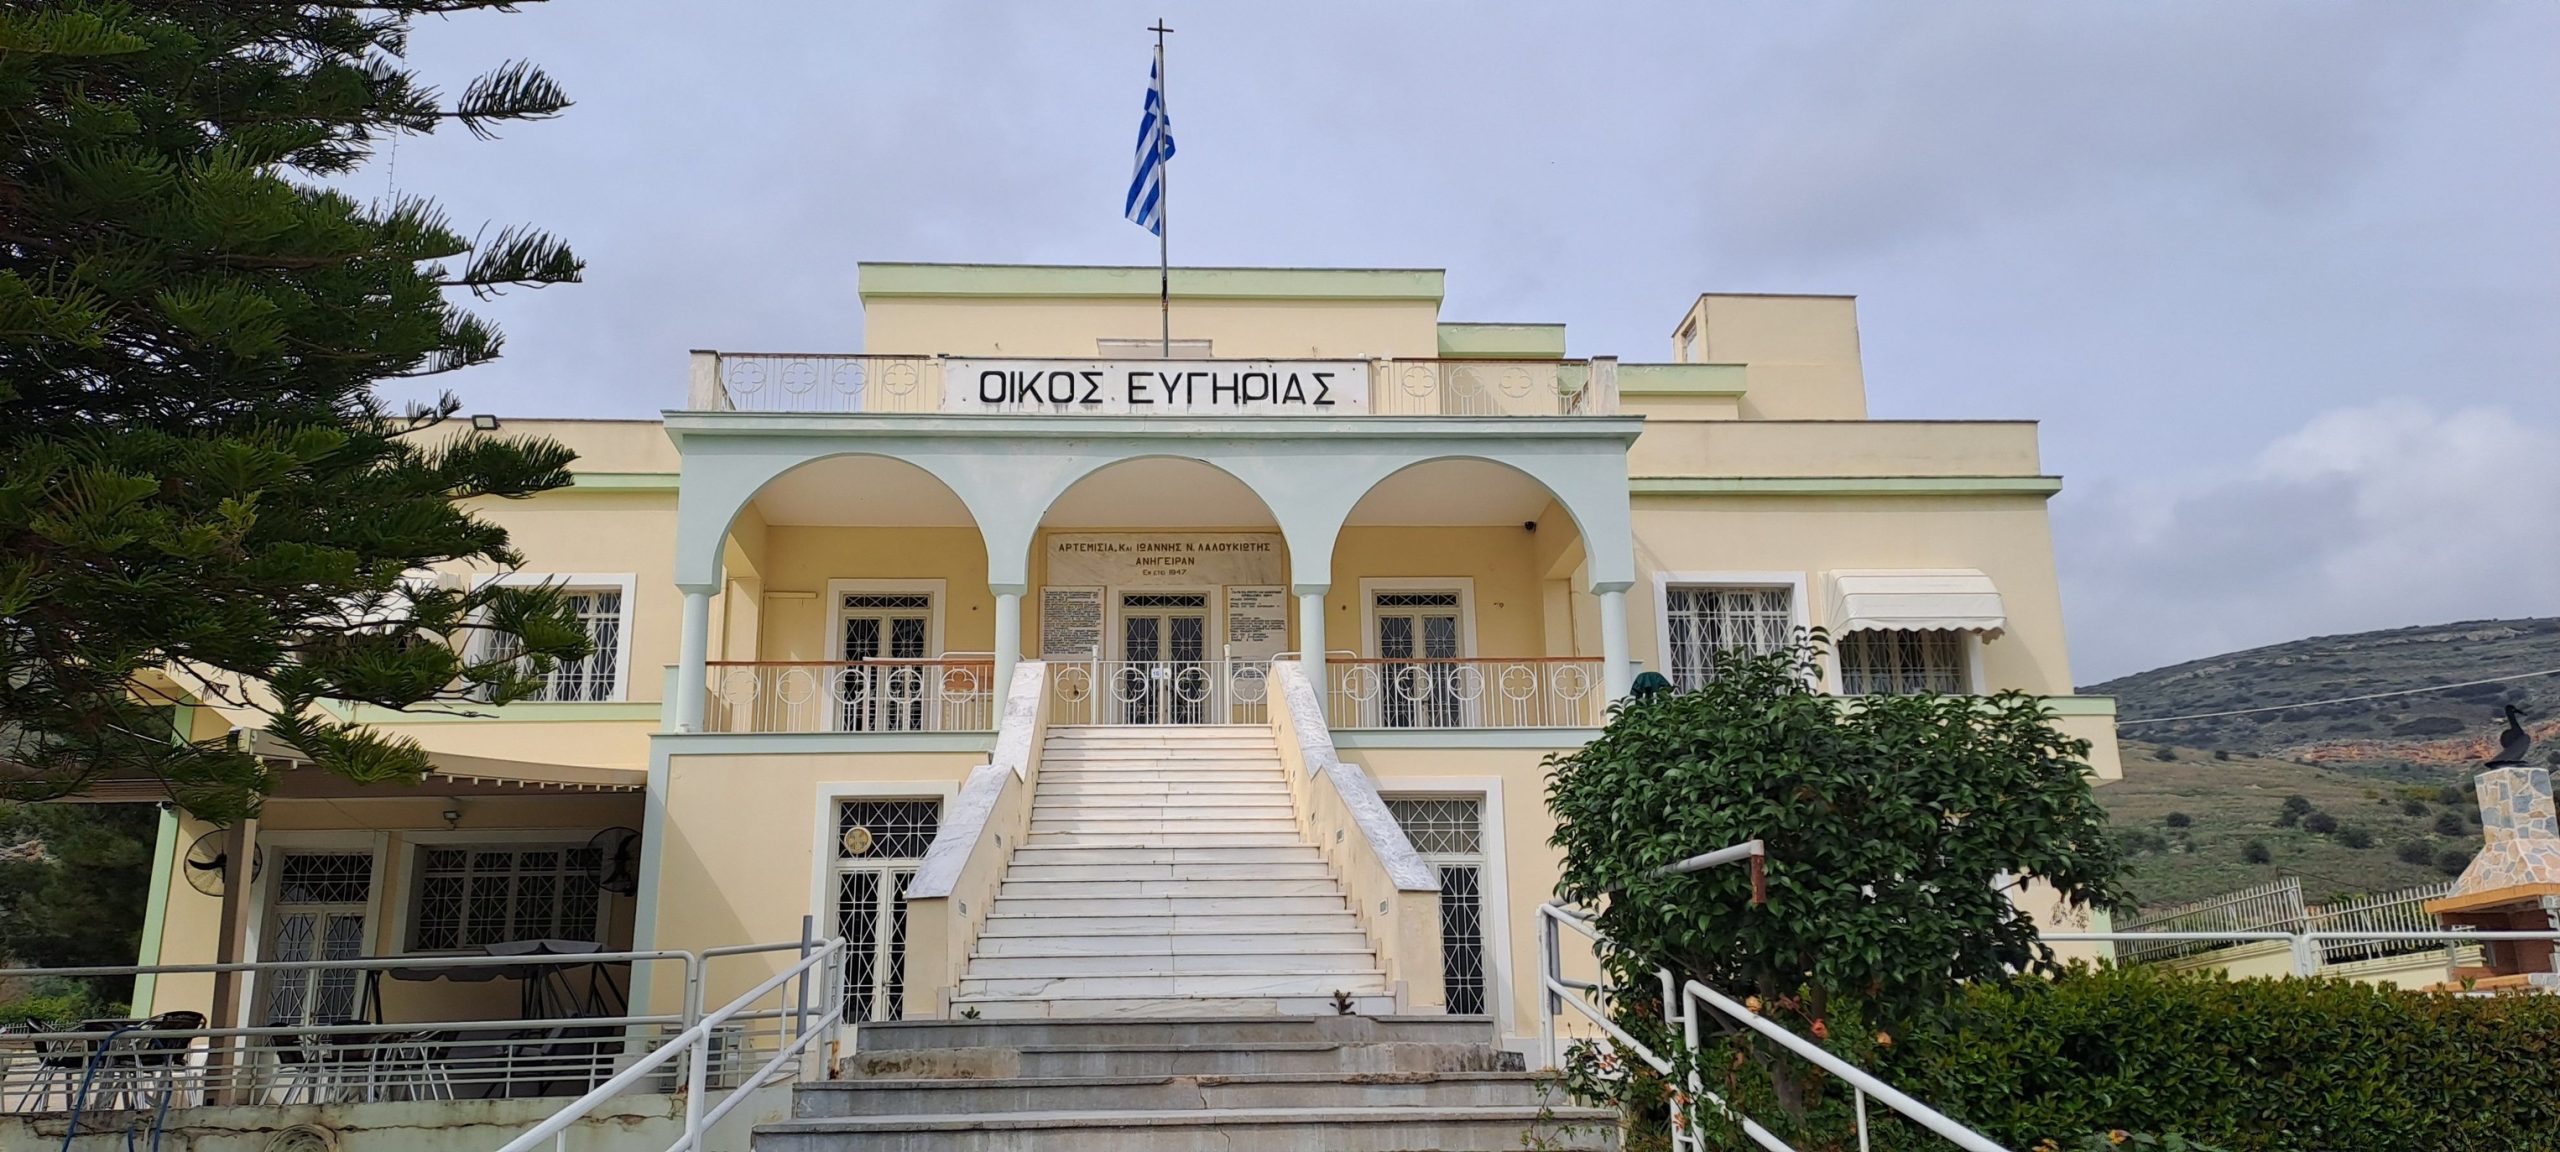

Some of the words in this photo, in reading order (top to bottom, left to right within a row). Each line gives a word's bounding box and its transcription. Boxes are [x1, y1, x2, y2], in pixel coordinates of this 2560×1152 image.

[979, 370, 1104, 404] ΟΙΚΟΣ
[1127, 372, 1336, 405] ΕΥΓΗΡΙΑΣ
[1136, 543, 1182, 552] ΙΩΑΝΝΗΣ
[1198, 543, 1271, 552] ΛΑΛΟΥΚΙΩΤΗΣ
[1135, 556, 1195, 566] ΑΝΗΓΕΙΡΑΝ
